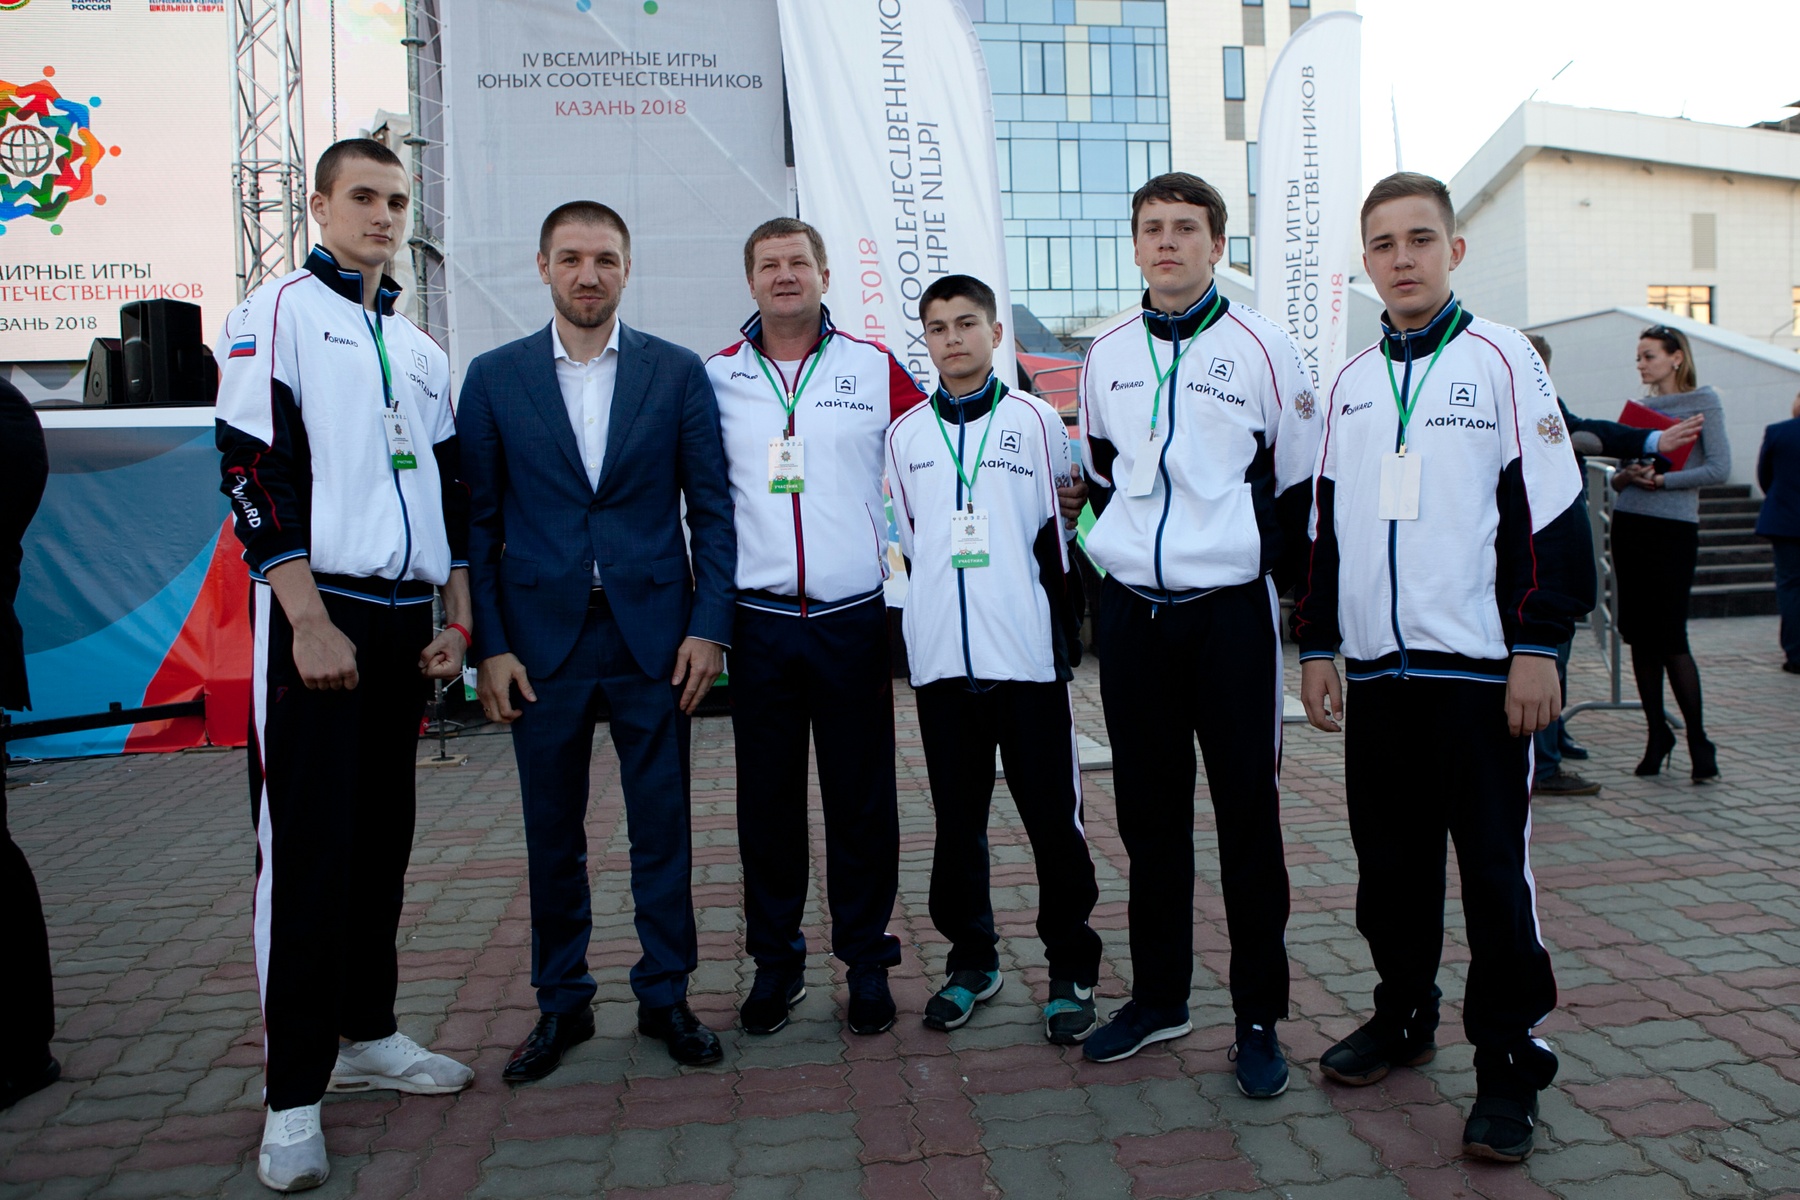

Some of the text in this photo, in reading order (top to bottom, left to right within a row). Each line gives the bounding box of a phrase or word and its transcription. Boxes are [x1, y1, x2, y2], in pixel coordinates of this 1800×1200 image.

[522, 53, 539, 67] IV
[543, 52, 717, 67] ВСЕМИРНЫЕ ИГРЫ
[477, 72, 763, 89] ЮНЫХ СООТЕЧЕСТВЕННИКОВ
[555, 99, 687, 116] КАЗАНЬ 2018
[1286, 179, 1300, 241] ИГРЫ
[1301, 65, 1320, 339] СООТЕЧЕСТВЕННИКОВ
[0, 263, 151, 280] ИРНЫЕ ИГРЫ
[55, 316, 97, 330] 2018
